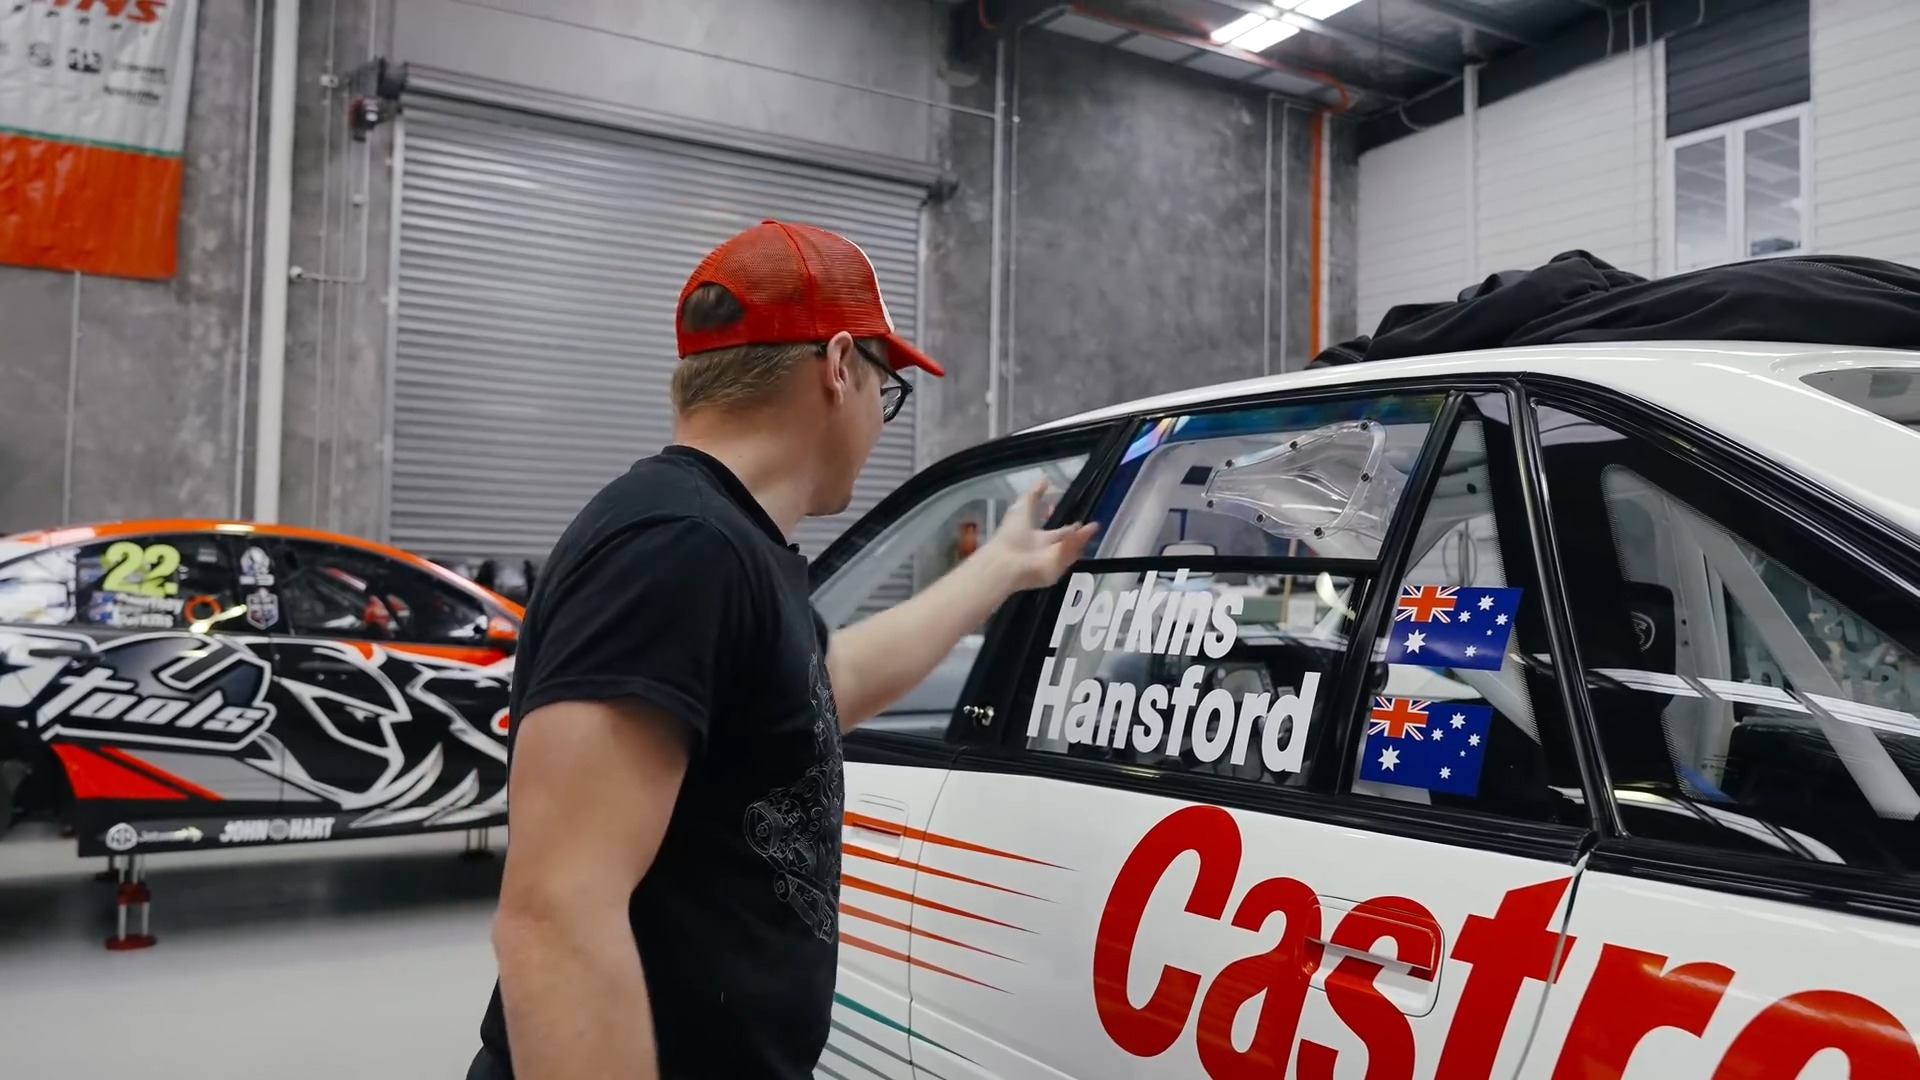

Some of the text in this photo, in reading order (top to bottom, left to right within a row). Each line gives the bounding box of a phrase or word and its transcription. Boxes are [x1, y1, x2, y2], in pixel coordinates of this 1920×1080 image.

[1050, 569, 1244, 658] Perkins
[36, 667, 267, 733] tools
[1027, 657, 1319, 773] Hansford
[289, 817, 336, 840] HART
